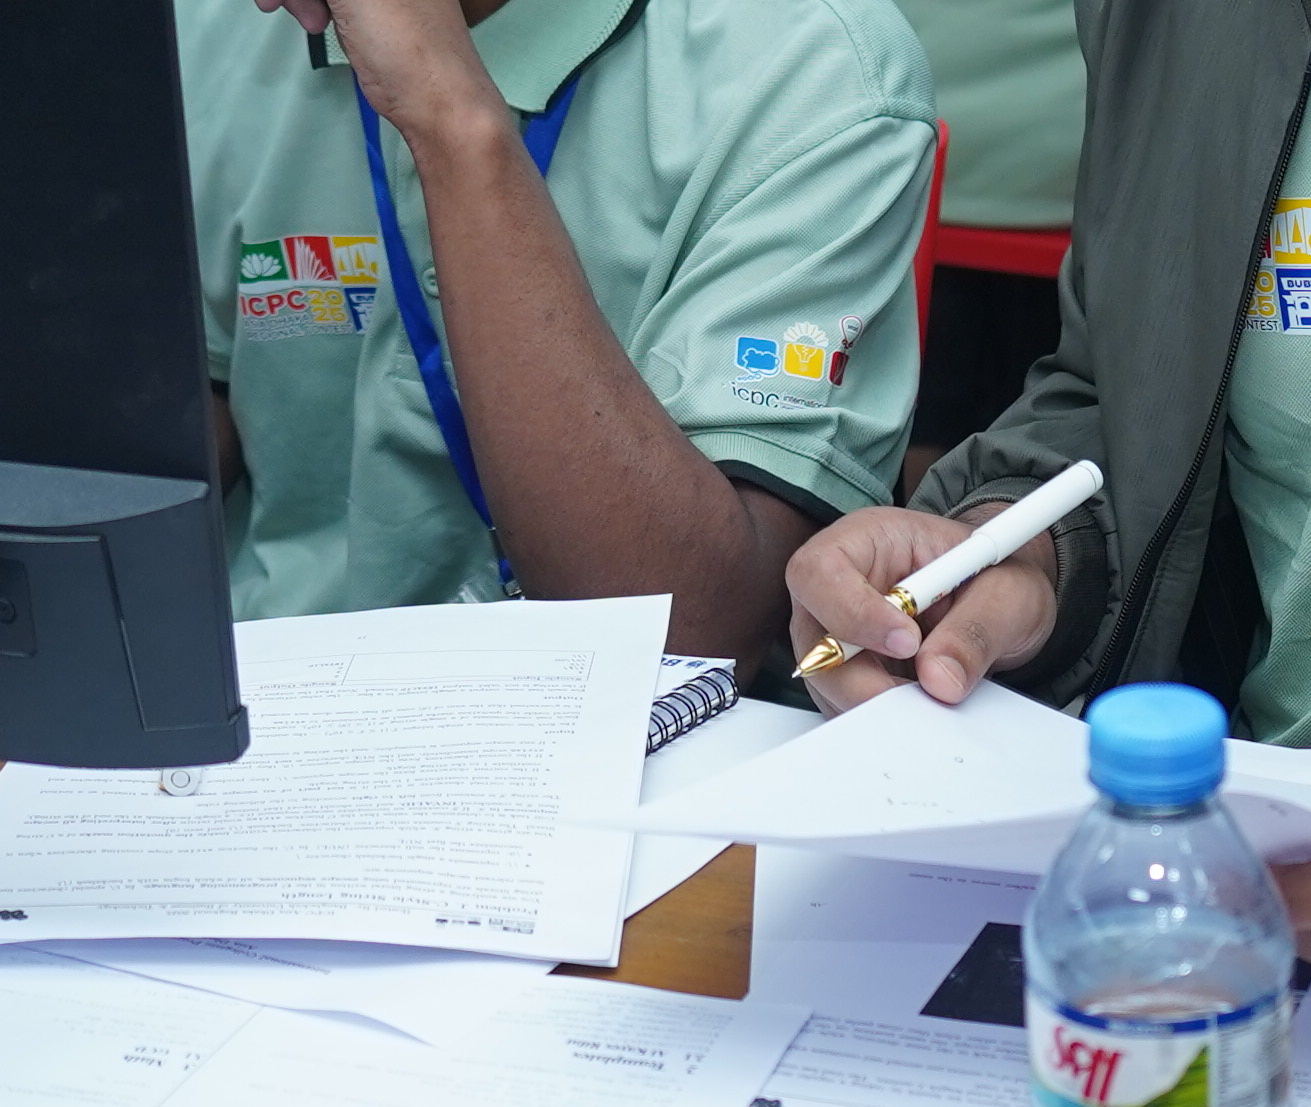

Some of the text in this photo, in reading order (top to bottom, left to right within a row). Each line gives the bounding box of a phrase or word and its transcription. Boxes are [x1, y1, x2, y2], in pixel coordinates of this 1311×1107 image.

[240, 290, 343, 317] ICPC 20
[313, 307, 347, 322] 25
[731, 382, 779, 409] icpc
[200, 882, 278, 890] programming
[281, 892, 333, 900] Length
[340, 892, 386, 902] String
[392, 896, 449, 908] C-Style
[475, 904, 538, 915] Problem
